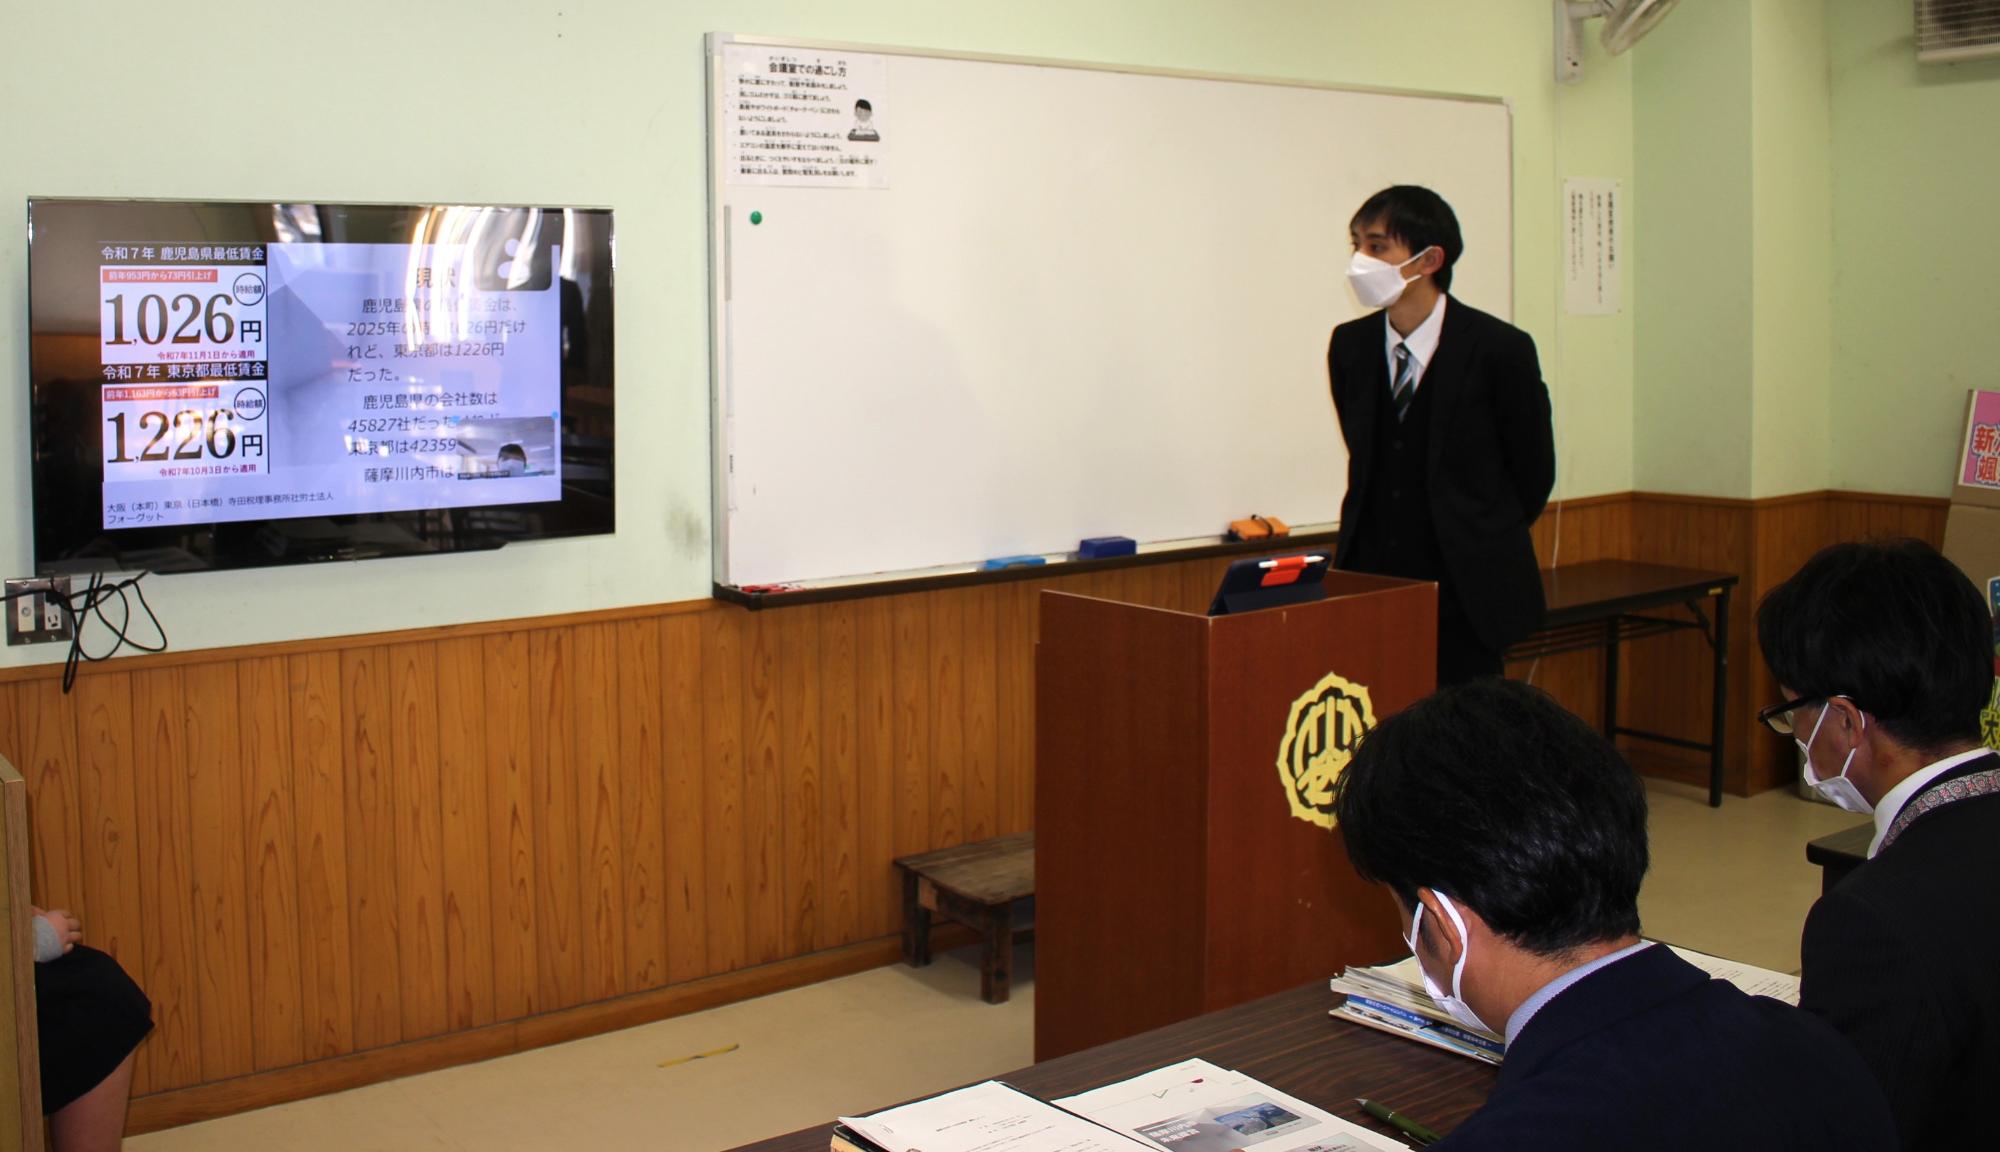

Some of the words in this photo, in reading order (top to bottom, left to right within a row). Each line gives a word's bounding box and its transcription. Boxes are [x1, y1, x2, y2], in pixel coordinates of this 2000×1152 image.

[769, 62, 847, 77] 会議室での過ごし方
[160, 246, 264, 261] 鹿児島県最低賃金
[167, 363, 265, 379] 東京都最低賃金
[348, 367, 400, 382] だった。
[362, 392, 498, 410] 鹿児島県の会社数は
